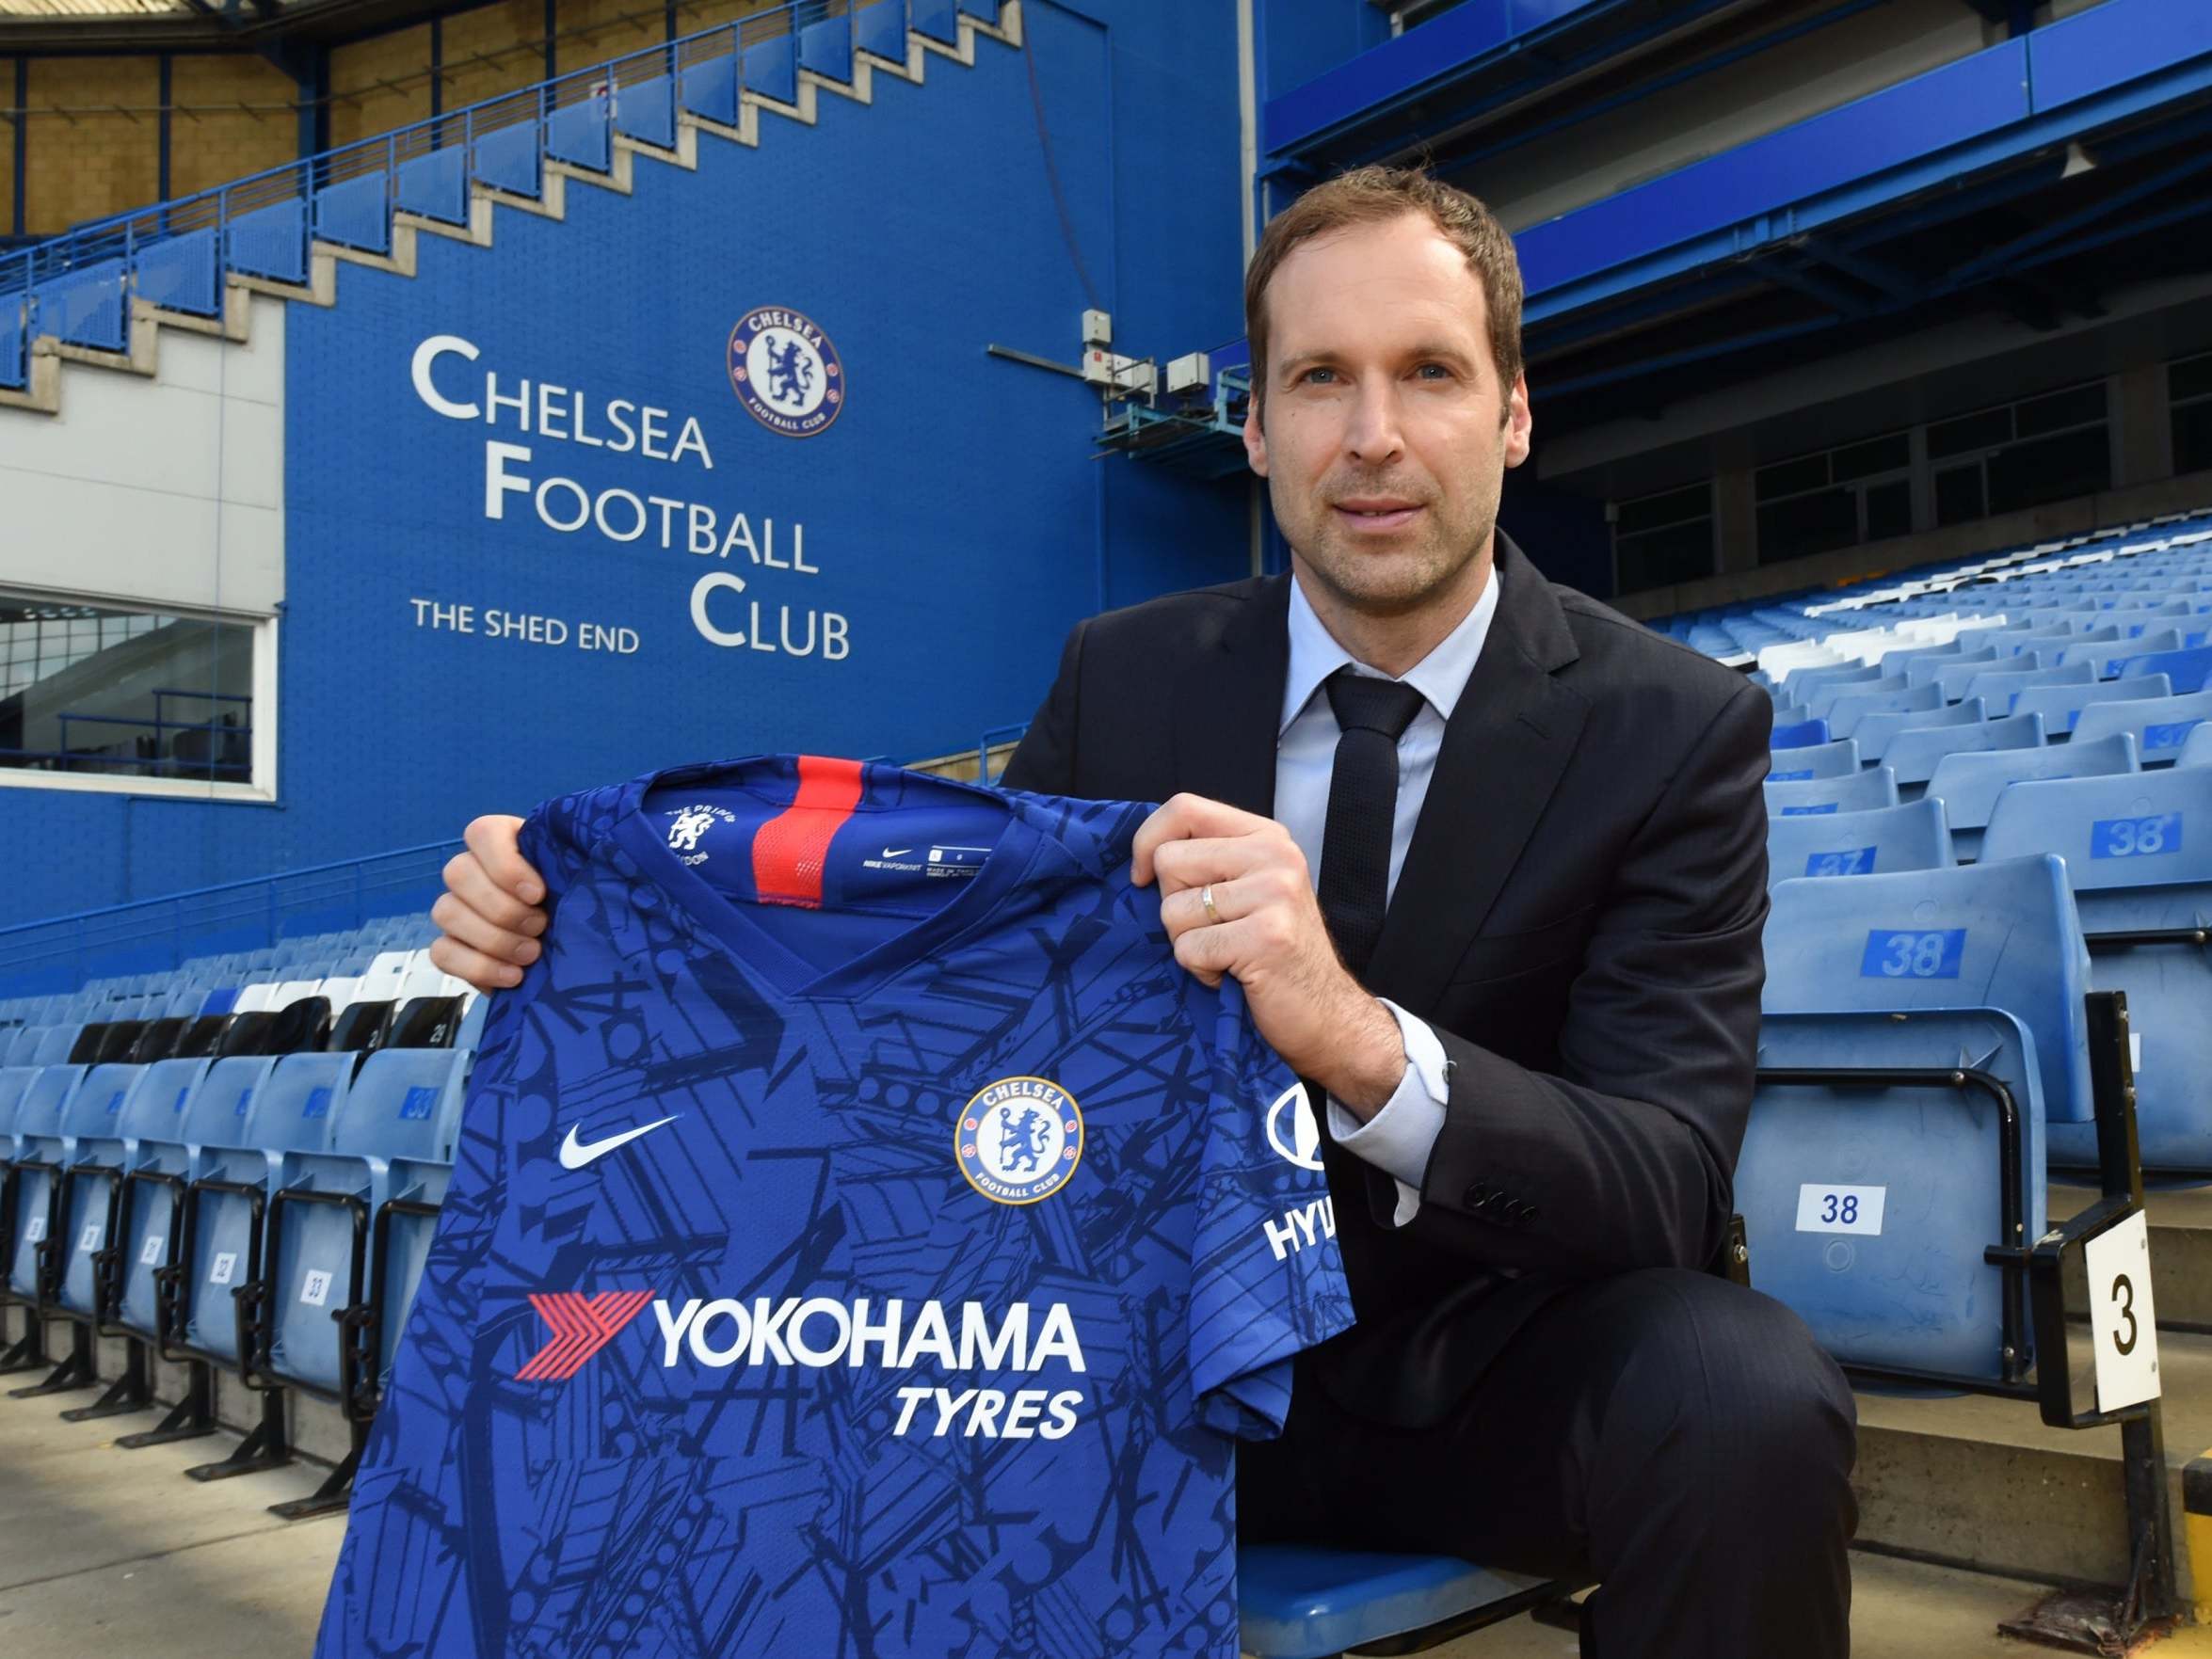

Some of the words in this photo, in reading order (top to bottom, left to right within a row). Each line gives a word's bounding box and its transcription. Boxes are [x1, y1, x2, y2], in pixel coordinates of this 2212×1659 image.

[748, 311, 822, 349] CHELSEA
[410, 334, 713, 470] CHELSEA
[748, 396, 799, 430] FOOTBALL
[485, 439, 819, 574] FOOTBALL
[409, 598, 474, 633] THE
[485, 610, 568, 646] SHED
[578, 624, 640, 654] END
[690, 570, 849, 660] CLUB
[2108, 819, 2164, 856] 38
[1883, 933, 1946, 977] 38
[983, 1081, 1065, 1110] CHELSEA
[974, 1172, 1030, 1198] FOOTBALL
[1032, 1172, 1061, 1193] CLUB
[1820, 1194, 1859, 1224] 38
[651, 1297, 1087, 1374] YOKOHAMA
[2111, 1273, 2138, 1356] 3
[892, 1386, 1085, 1441] TYRES
